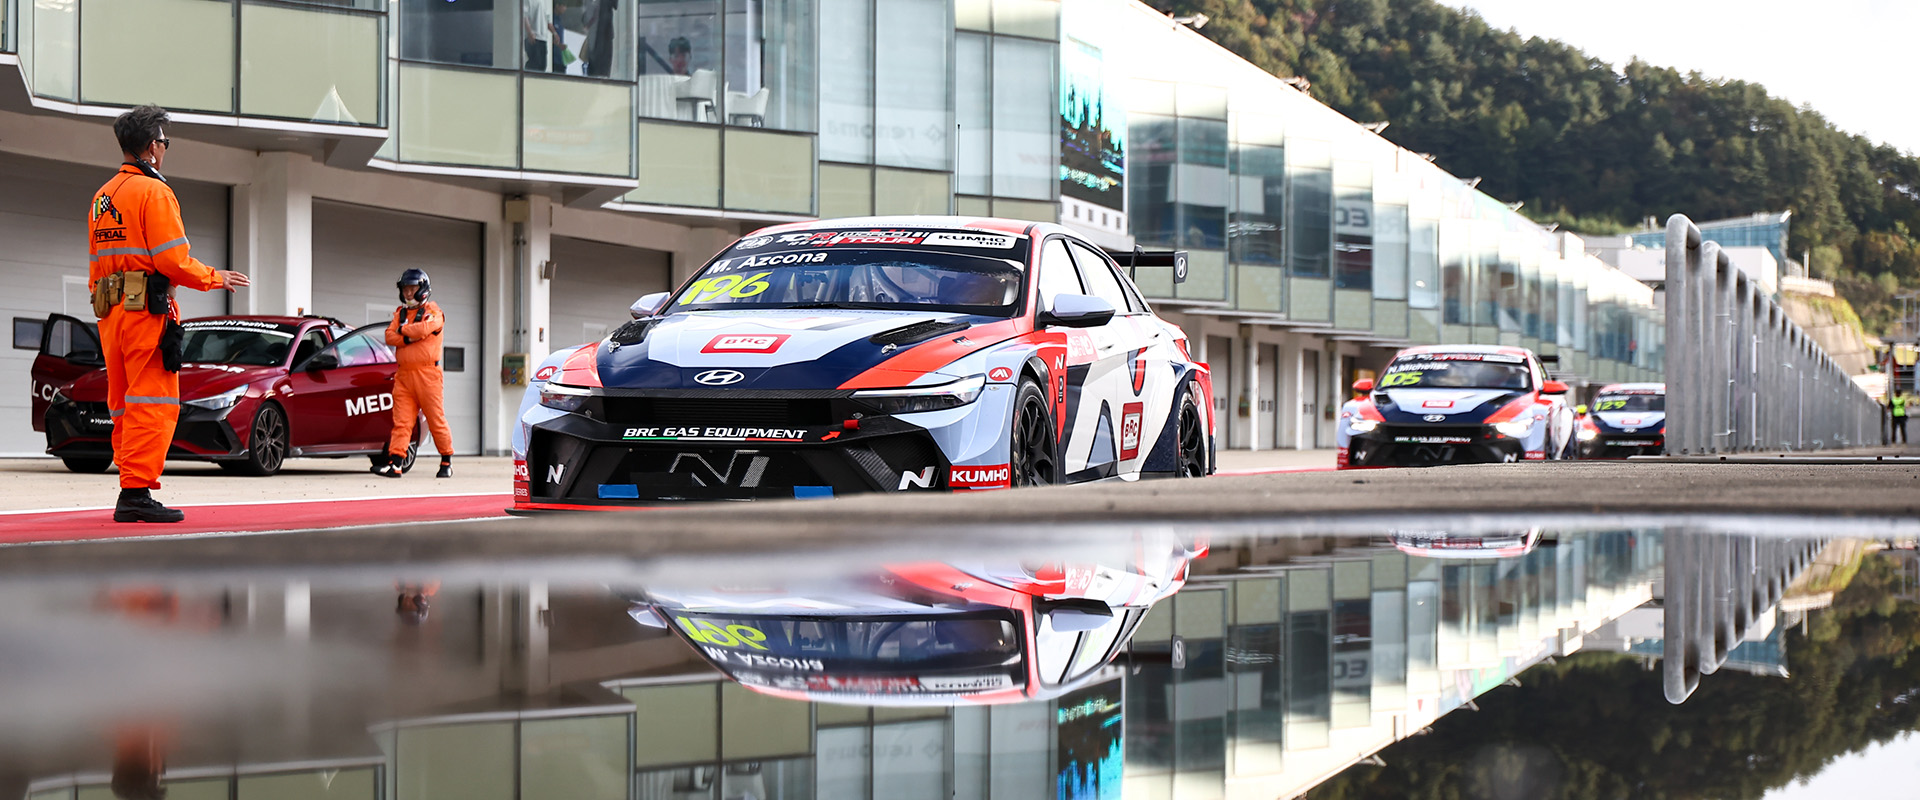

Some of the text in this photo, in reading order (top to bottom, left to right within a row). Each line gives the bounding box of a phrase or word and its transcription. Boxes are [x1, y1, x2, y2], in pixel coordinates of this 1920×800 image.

[848, 236, 916, 244] TOUR
[938, 234, 1006, 243] KUMHO
[706, 252, 828, 275] M. Azcona
[679, 271, 773, 306] 196
[724, 337, 768, 345] BRC
[1381, 371, 1424, 387] 105
[345, 392, 394, 417] MED
[1593, 400, 1627, 412] 129
[623, 427, 808, 439] BRC GAS EQUIPMENT
[951, 468, 1009, 483] KUMHO
